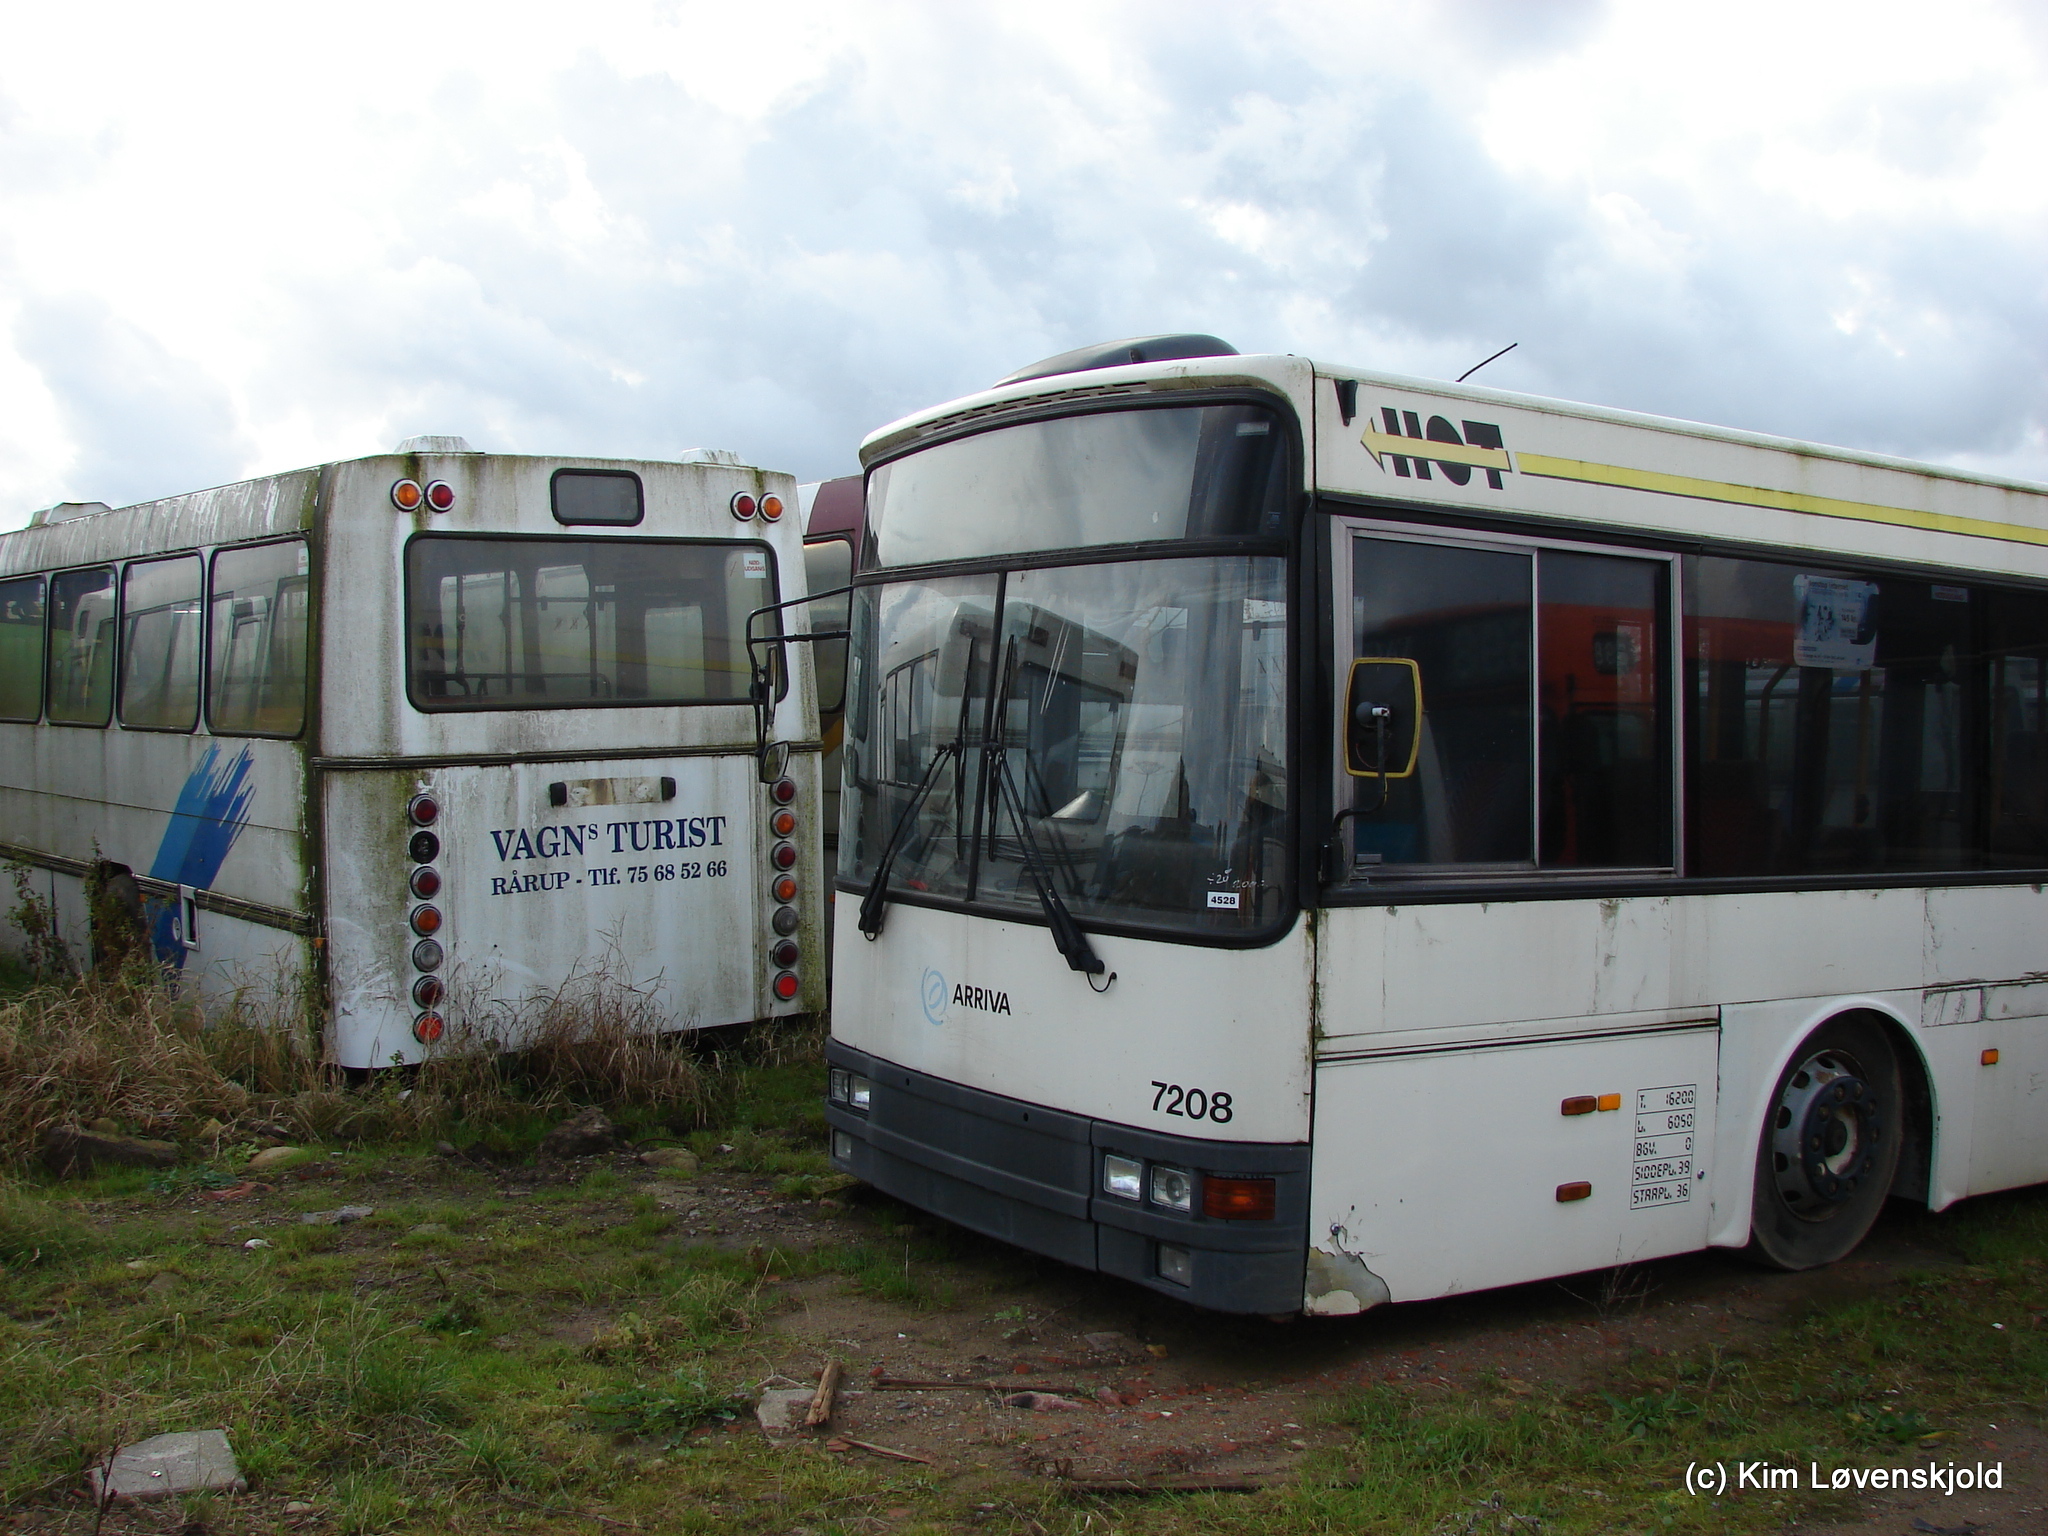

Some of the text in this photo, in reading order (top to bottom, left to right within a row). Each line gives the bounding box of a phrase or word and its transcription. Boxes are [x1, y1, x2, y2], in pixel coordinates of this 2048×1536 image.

[606, 815, 727, 853] TURIST
[491, 870, 570, 895] RÅRUP
[588, 867, 621, 886] Tlf.
[627, 865, 648, 883] 75
[654, 863, 675, 881] 68
[681, 861, 701, 879] 52
[706, 859, 727, 877] 66
[1210, 896, 1236, 905] 4528
[952, 983, 1011, 1016] ARRIVA
[1151, 1080, 1233, 1123] 7208
[1666, 1089, 1694, 1106] 16200
[1667, 1113, 1693, 1129] 6050
[1685, 1137, 1692, 1150] 0
[1634, 1160, 1691, 1181] SIDDEPL. 39
[1676, 1183, 1689, 1198] 36
